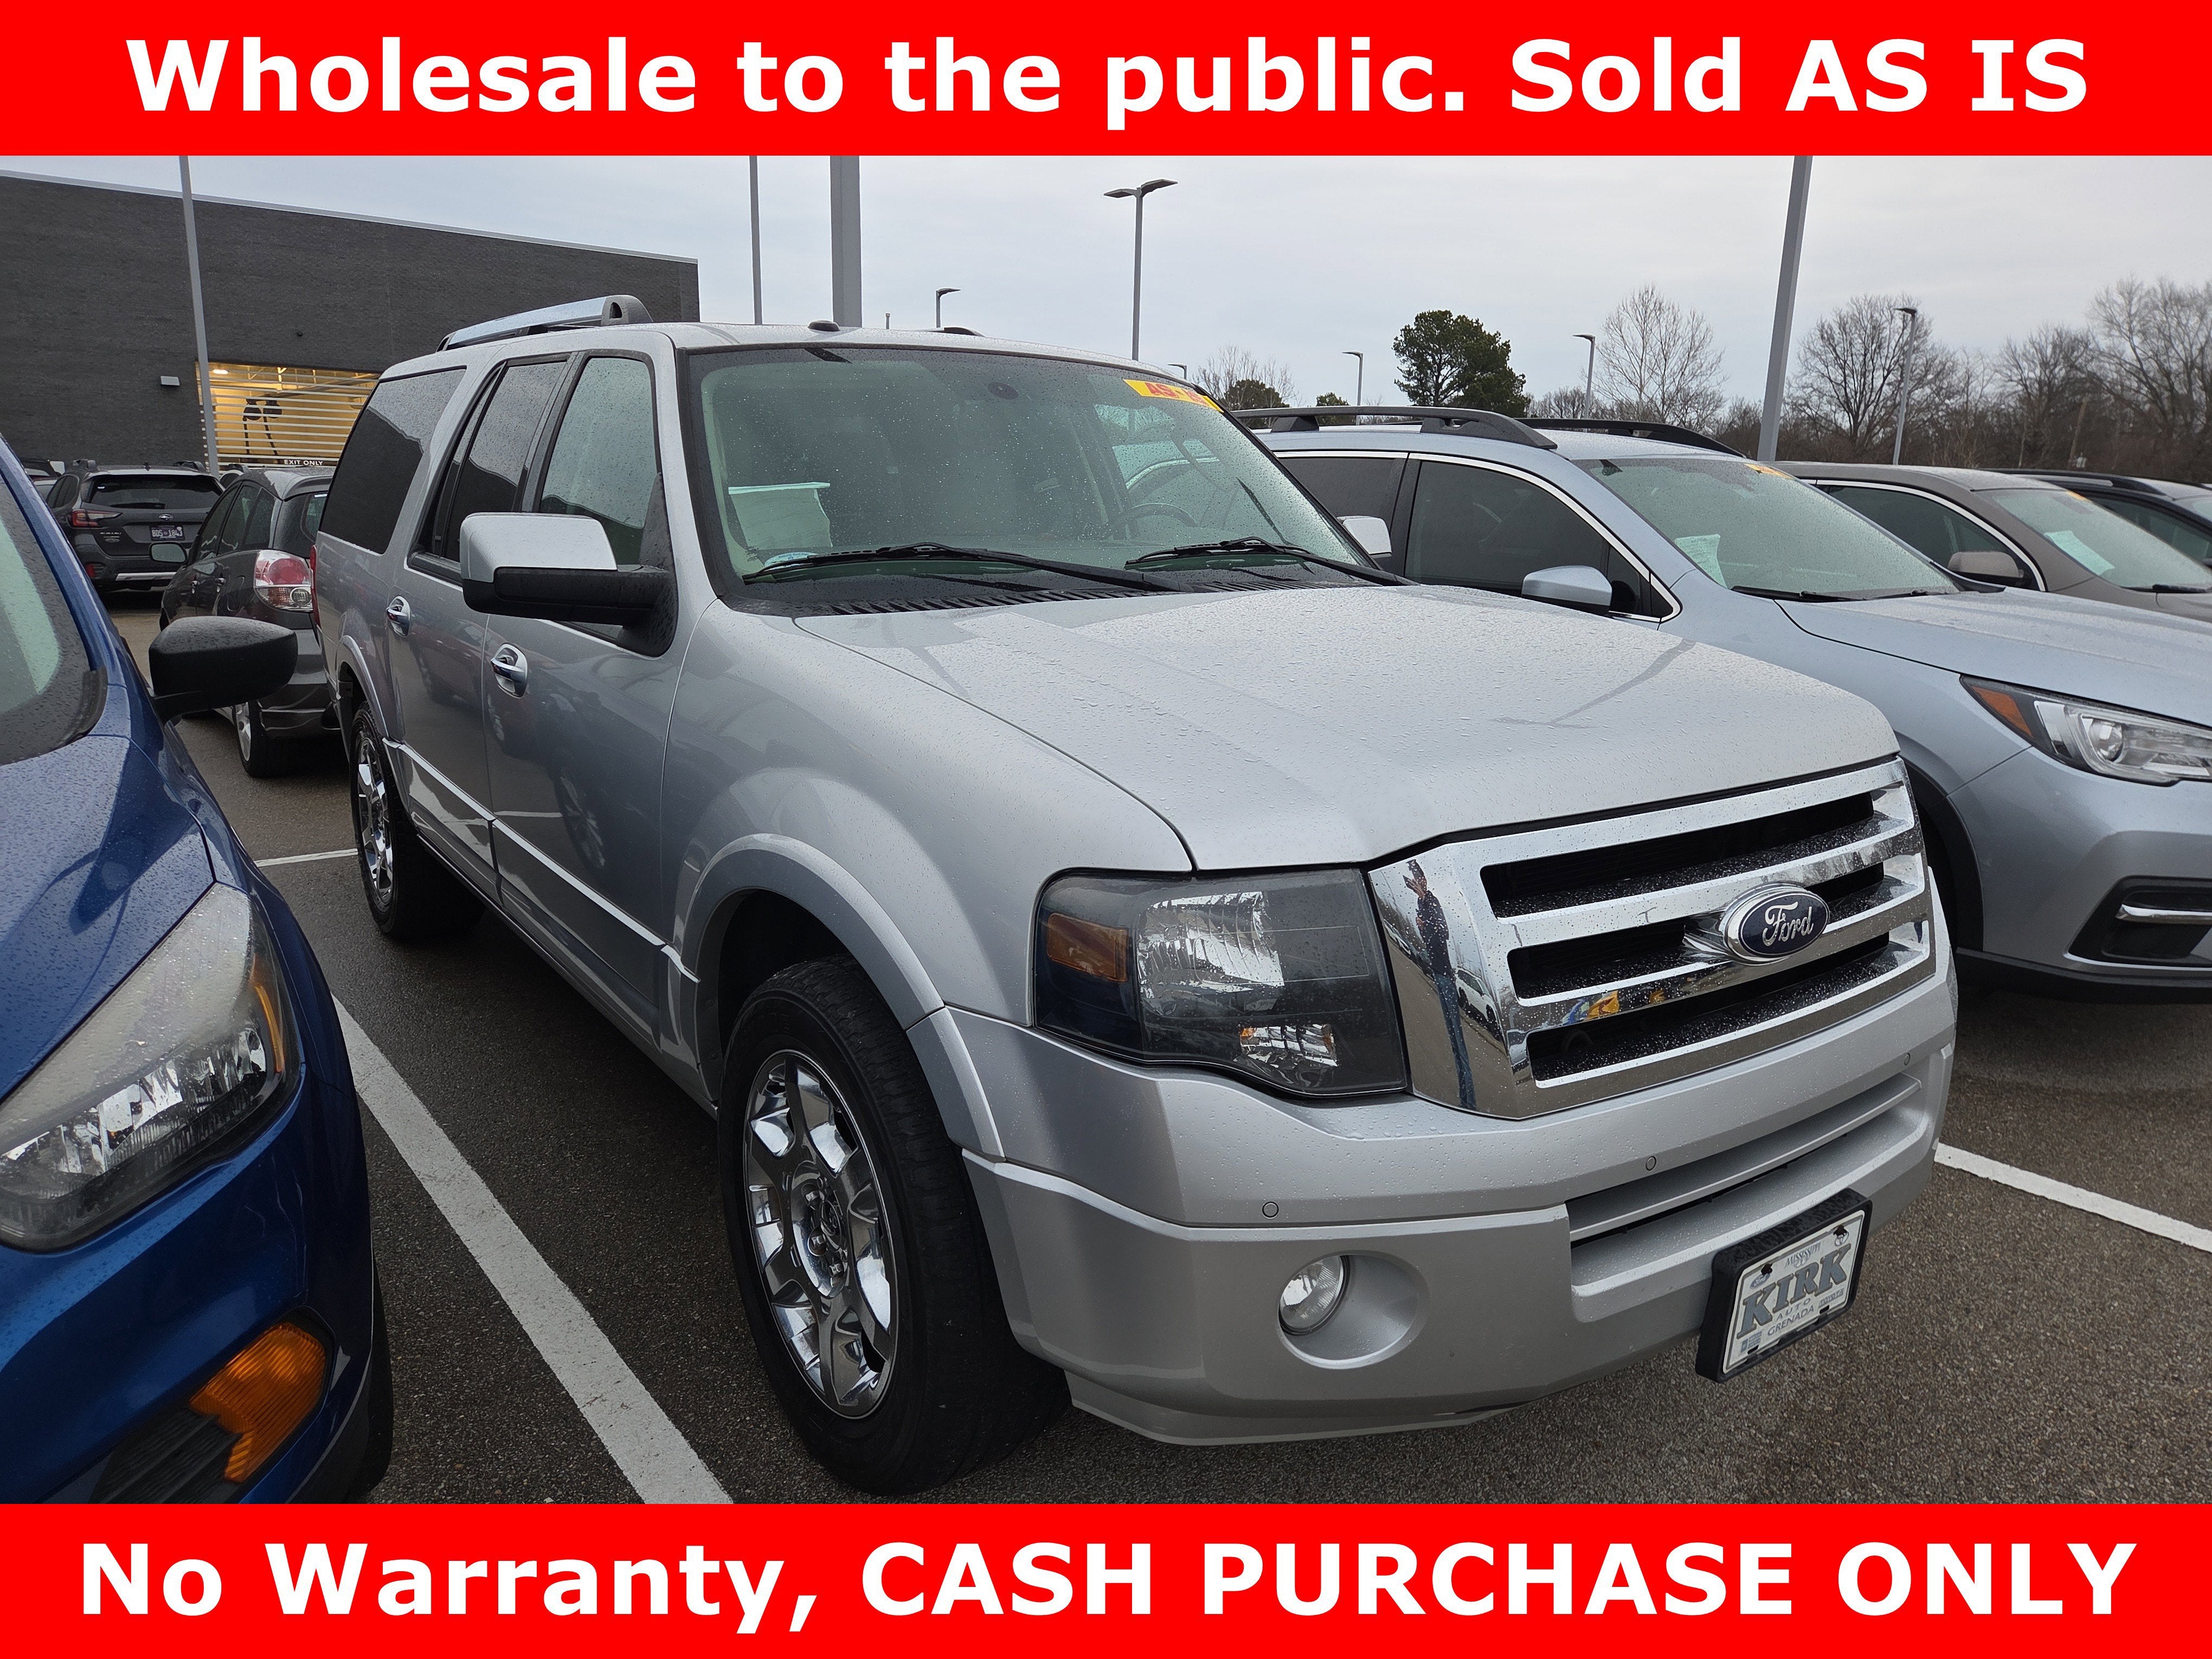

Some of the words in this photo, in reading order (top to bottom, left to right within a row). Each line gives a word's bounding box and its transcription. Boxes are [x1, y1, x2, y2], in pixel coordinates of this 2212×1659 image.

[1762, 901, 1814, 947] Ford
[1737, 1243, 1851, 1339] KIRK
[1776, 1297, 1811, 1321] AUTO
[1767, 1304, 1814, 1336] GRENADA
